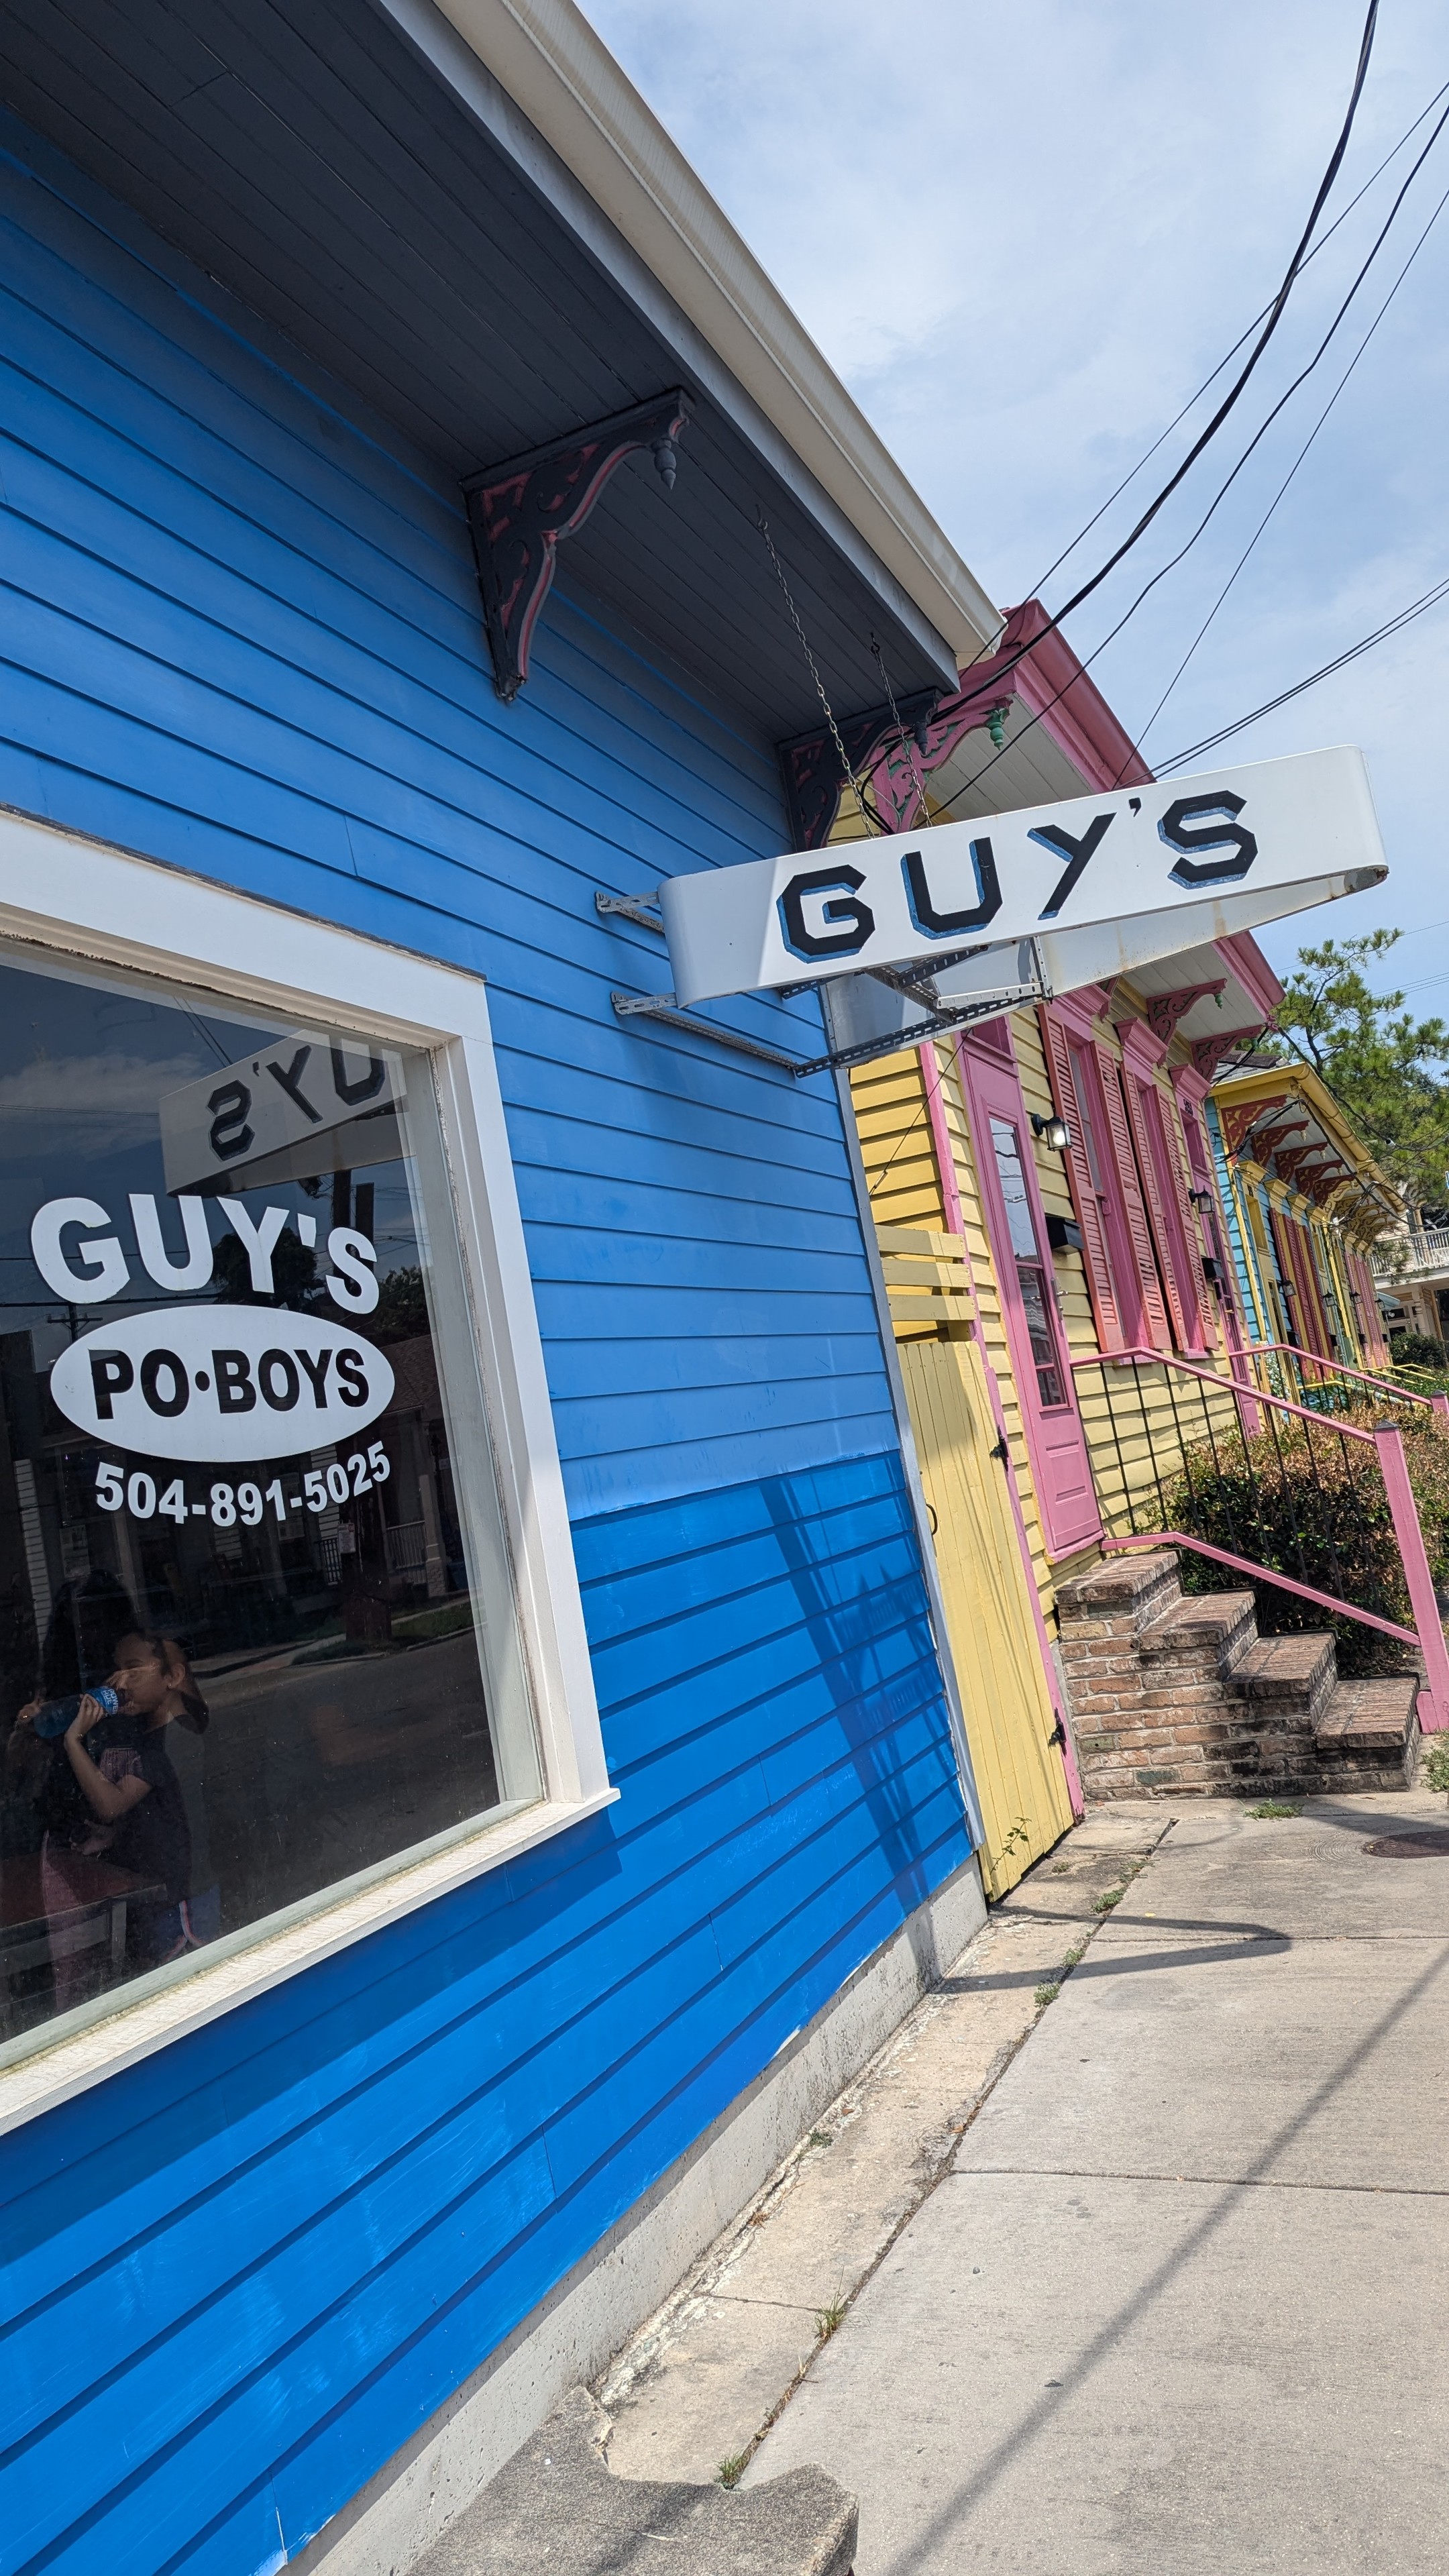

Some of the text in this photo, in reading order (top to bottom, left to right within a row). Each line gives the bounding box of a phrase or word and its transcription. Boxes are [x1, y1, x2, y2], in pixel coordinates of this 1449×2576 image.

[776, 790, 1258, 964] GUY'S
[31, 1193, 380, 1314] GUY'S
[95, 1441, 391, 1527] 504-891-5025
